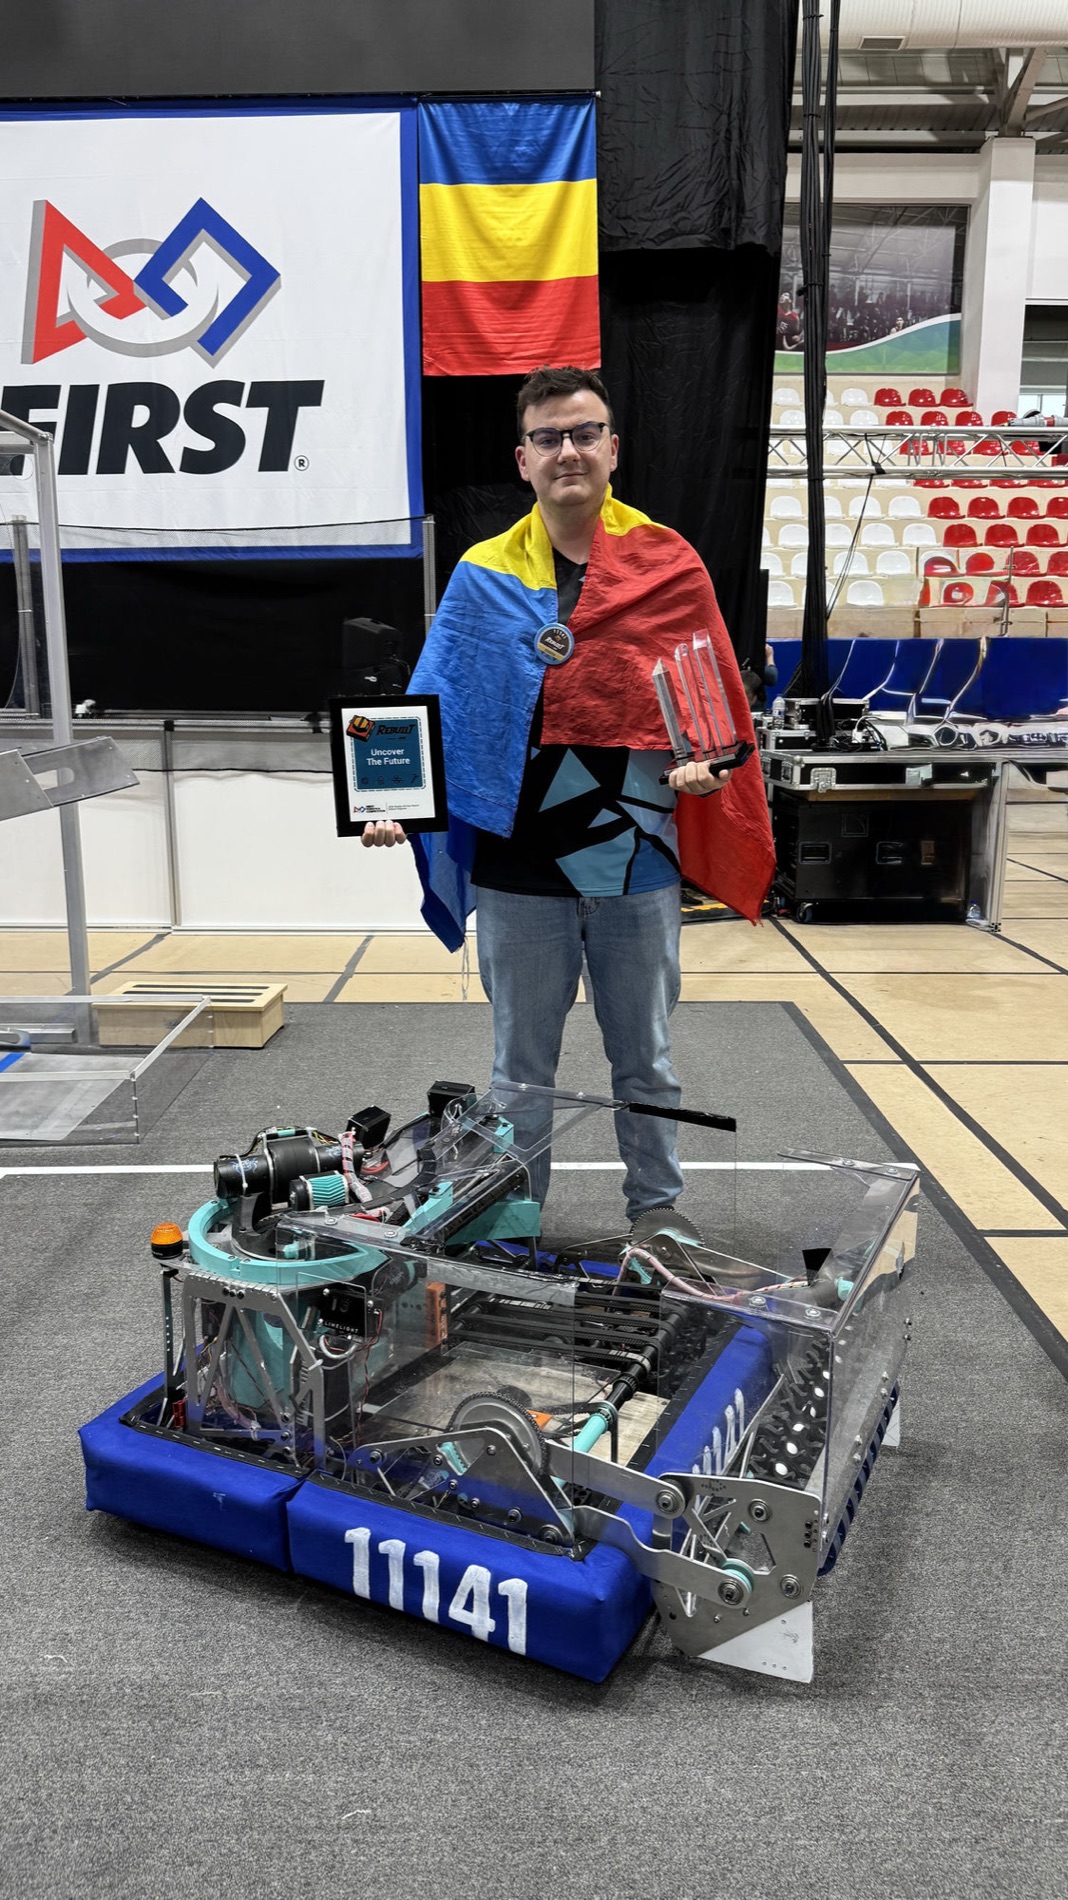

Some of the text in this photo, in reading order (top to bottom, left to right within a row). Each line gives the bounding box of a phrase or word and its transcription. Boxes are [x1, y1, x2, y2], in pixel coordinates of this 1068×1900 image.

[366, 757, 411, 766] The Future
[345, 1527, 528, 1655] 11141
